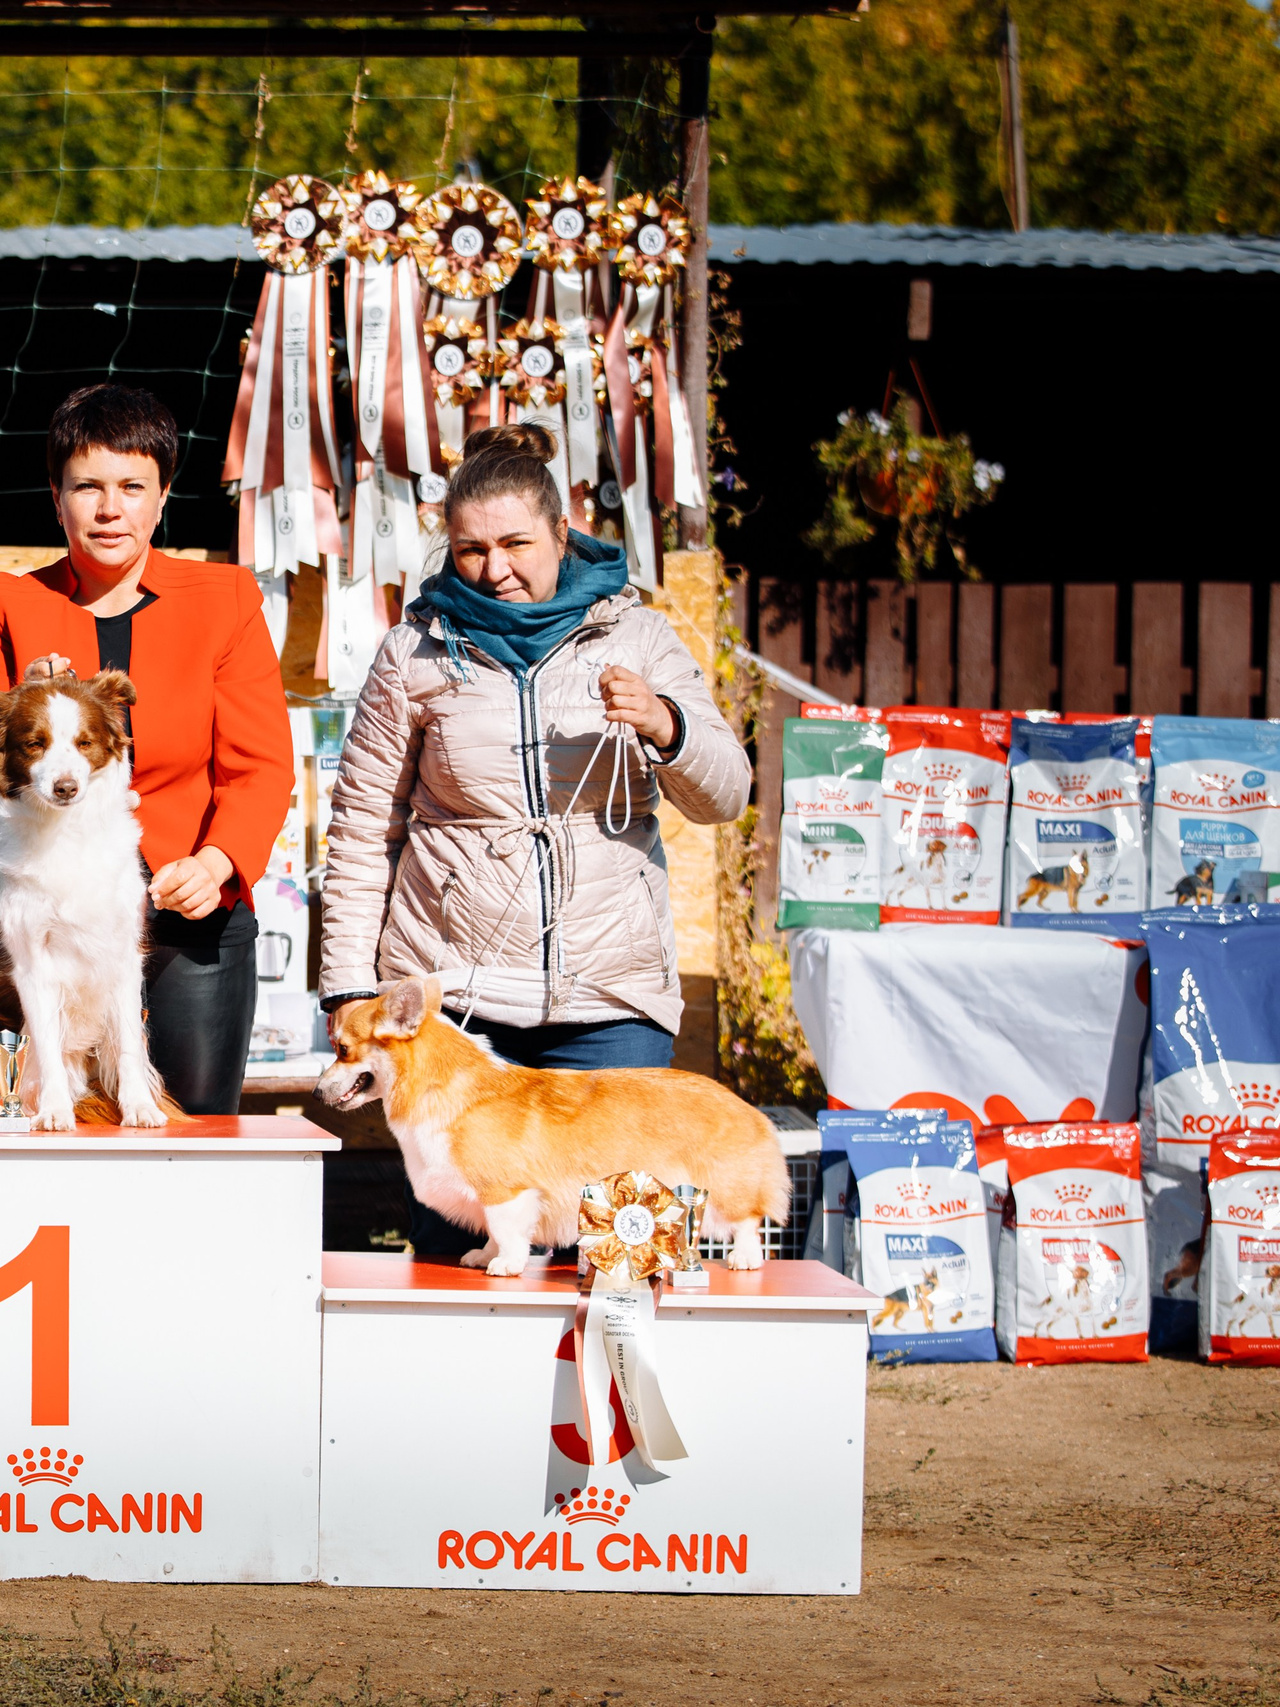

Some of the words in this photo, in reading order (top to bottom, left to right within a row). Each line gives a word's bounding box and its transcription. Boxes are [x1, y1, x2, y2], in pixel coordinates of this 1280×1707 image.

[895, 780, 938, 797] ROYAL
[1028, 790, 1070, 807] ROYAL
[1074, 789, 1123, 808] CANIN
[1172, 791, 1214, 808] ROYAL
[1217, 790, 1267, 808] CANIN
[795, 801, 830, 813] ROYAL
[834, 801, 873, 812] CANIN
[803, 825, 836, 837] MINI
[1039, 822, 1081, 836] MAXI
[1201, 822, 1227, 831] PUPPY
[1184, 830, 1205, 840] ДЛЯ
[1206, 832, 1245, 842] ЩЕНКОВ
[1092, 843, 1117, 854] Adult
[1182, 1114, 1248, 1134] ROYAL
[874, 1204, 913, 1219] ROYAL
[917, 1199, 968, 1218] CANIN
[1030, 1208, 1071, 1222] ROYAL
[1075, 1203, 1126, 1221] CANIN
[1228, 1205, 1263, 1221] ROYA
[888, 1236, 928, 1252] MAXI
[1043, 1241, 1095, 1256] MEDUM
[1240, 1241, 1280, 1254] MEDIU
[942, 1258, 966, 1269] Adult
[620, 1371, 628, 1395] GROUP
[50, 1492, 202, 1534] CANIN
[438, 1529, 584, 1571] ROYAL
[596, 1533, 748, 1574] CANIN
